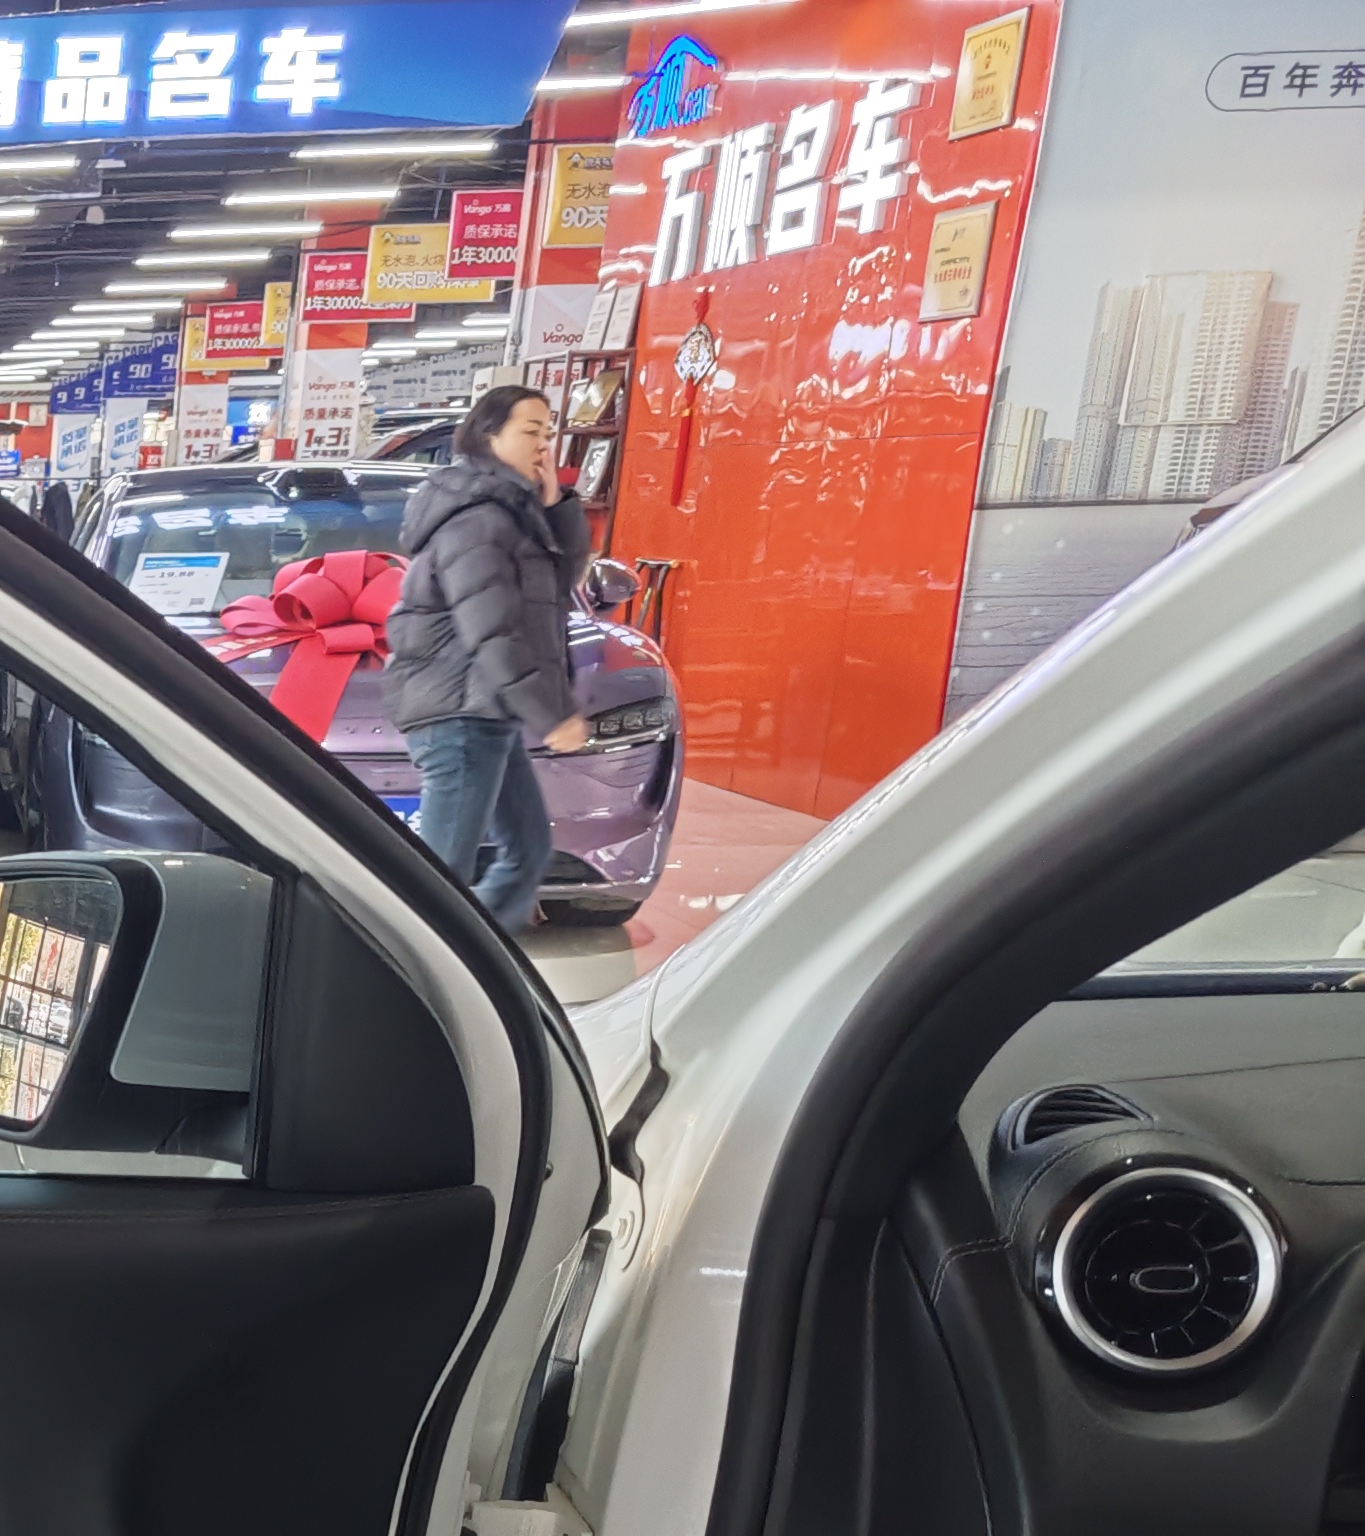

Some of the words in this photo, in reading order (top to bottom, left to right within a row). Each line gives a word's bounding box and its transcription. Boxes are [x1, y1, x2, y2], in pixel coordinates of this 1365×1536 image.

[648, 79, 925, 288] 万顺名车
[463, 223, 518, 239] 质保承诺
[543, 331, 584, 347] Vango
